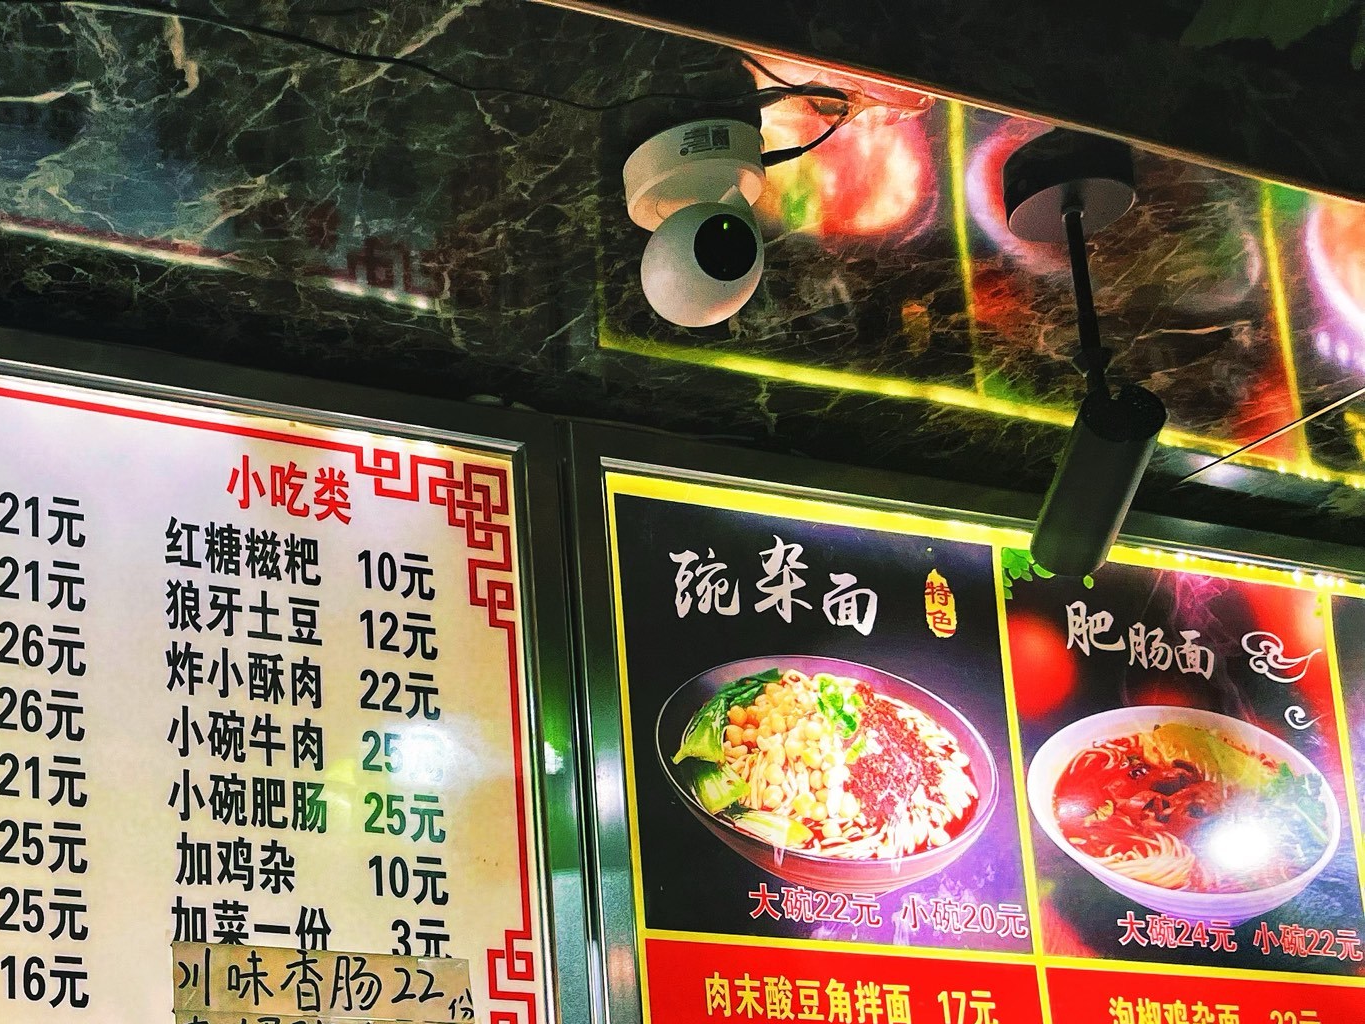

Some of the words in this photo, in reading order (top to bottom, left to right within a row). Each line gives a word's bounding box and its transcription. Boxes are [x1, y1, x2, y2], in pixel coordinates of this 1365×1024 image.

[227, 454, 353, 525] 小吃类
[165, 516, 322, 587] 红糖糍粑
[357, 549, 436, 601] 10元
[165, 578, 323, 647] 狼牙土豆
[359, 609, 438, 661] 12元
[923, 580, 956, 635] 特色
[1065, 600, 1216, 681] 肥肠面
[165, 641, 323, 709] 炸小酥肉
[359, 669, 441, 721] 22元
[166, 704, 325, 772] 小碗牛肉
[361, 729, 444, 782] 25
[167, 768, 328, 834] 小碗肥肠
[363, 791, 446, 844] 25元
[175, 831, 296, 895] 加鸡杂
[368, 855, 450, 906] 10元
[170, 895, 333, 952] 加菜一份
[390, 918, 453, 958] 3元
[747, 880, 882, 929] 大碗22元
[899, 895, 1031, 941] 小碗20元
[1116, 910, 1238, 952] 大碗24元
[1252, 921, 1365, 962] 小碗22元
[0, 954, 90, 1009] 16元
